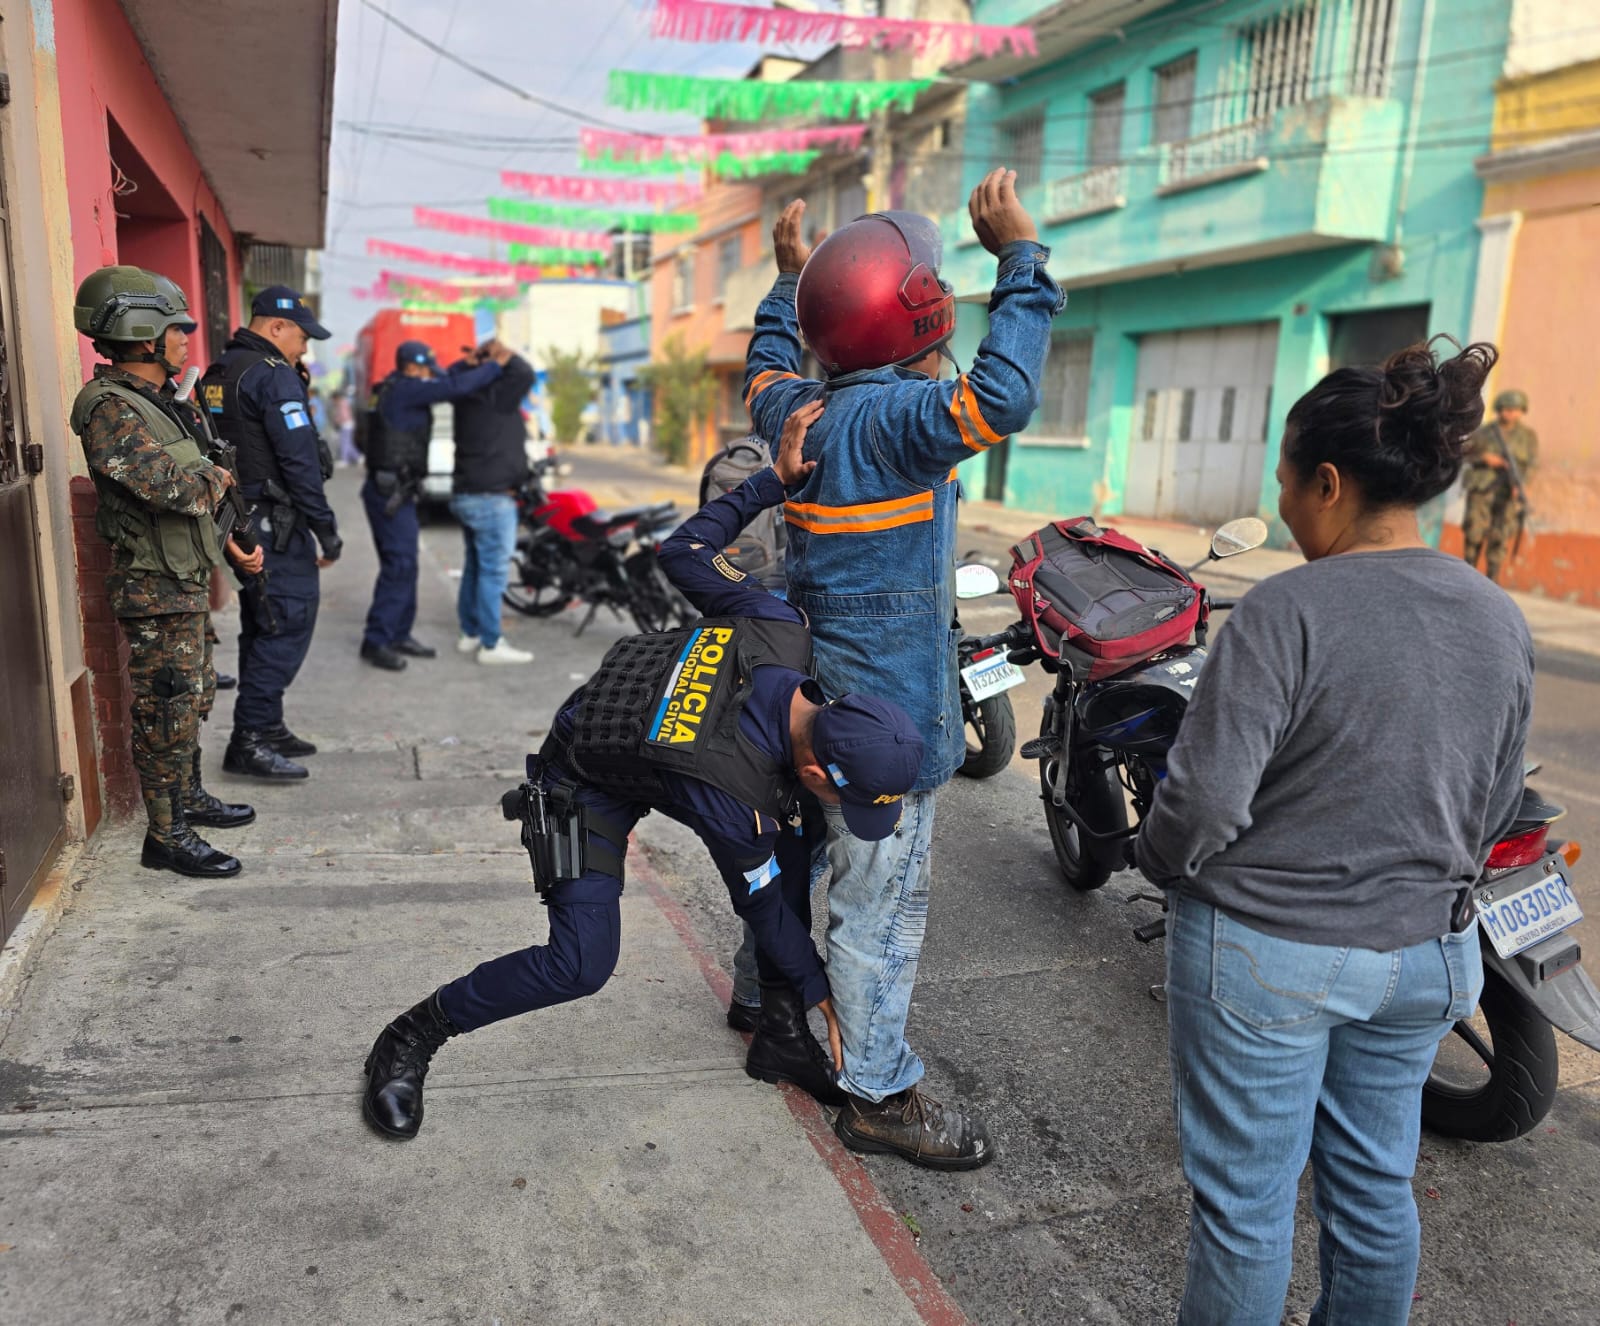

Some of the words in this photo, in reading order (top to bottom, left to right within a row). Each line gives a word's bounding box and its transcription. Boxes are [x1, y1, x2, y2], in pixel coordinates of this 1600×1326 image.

[669, 627, 734, 744] POLICIA
[673, 627, 714, 697] NACIONAL
[657, 700, 681, 742] CIVIL
[1515, 928, 1540, 946] CENTRO
[1540, 916, 1567, 935] AMERICA
